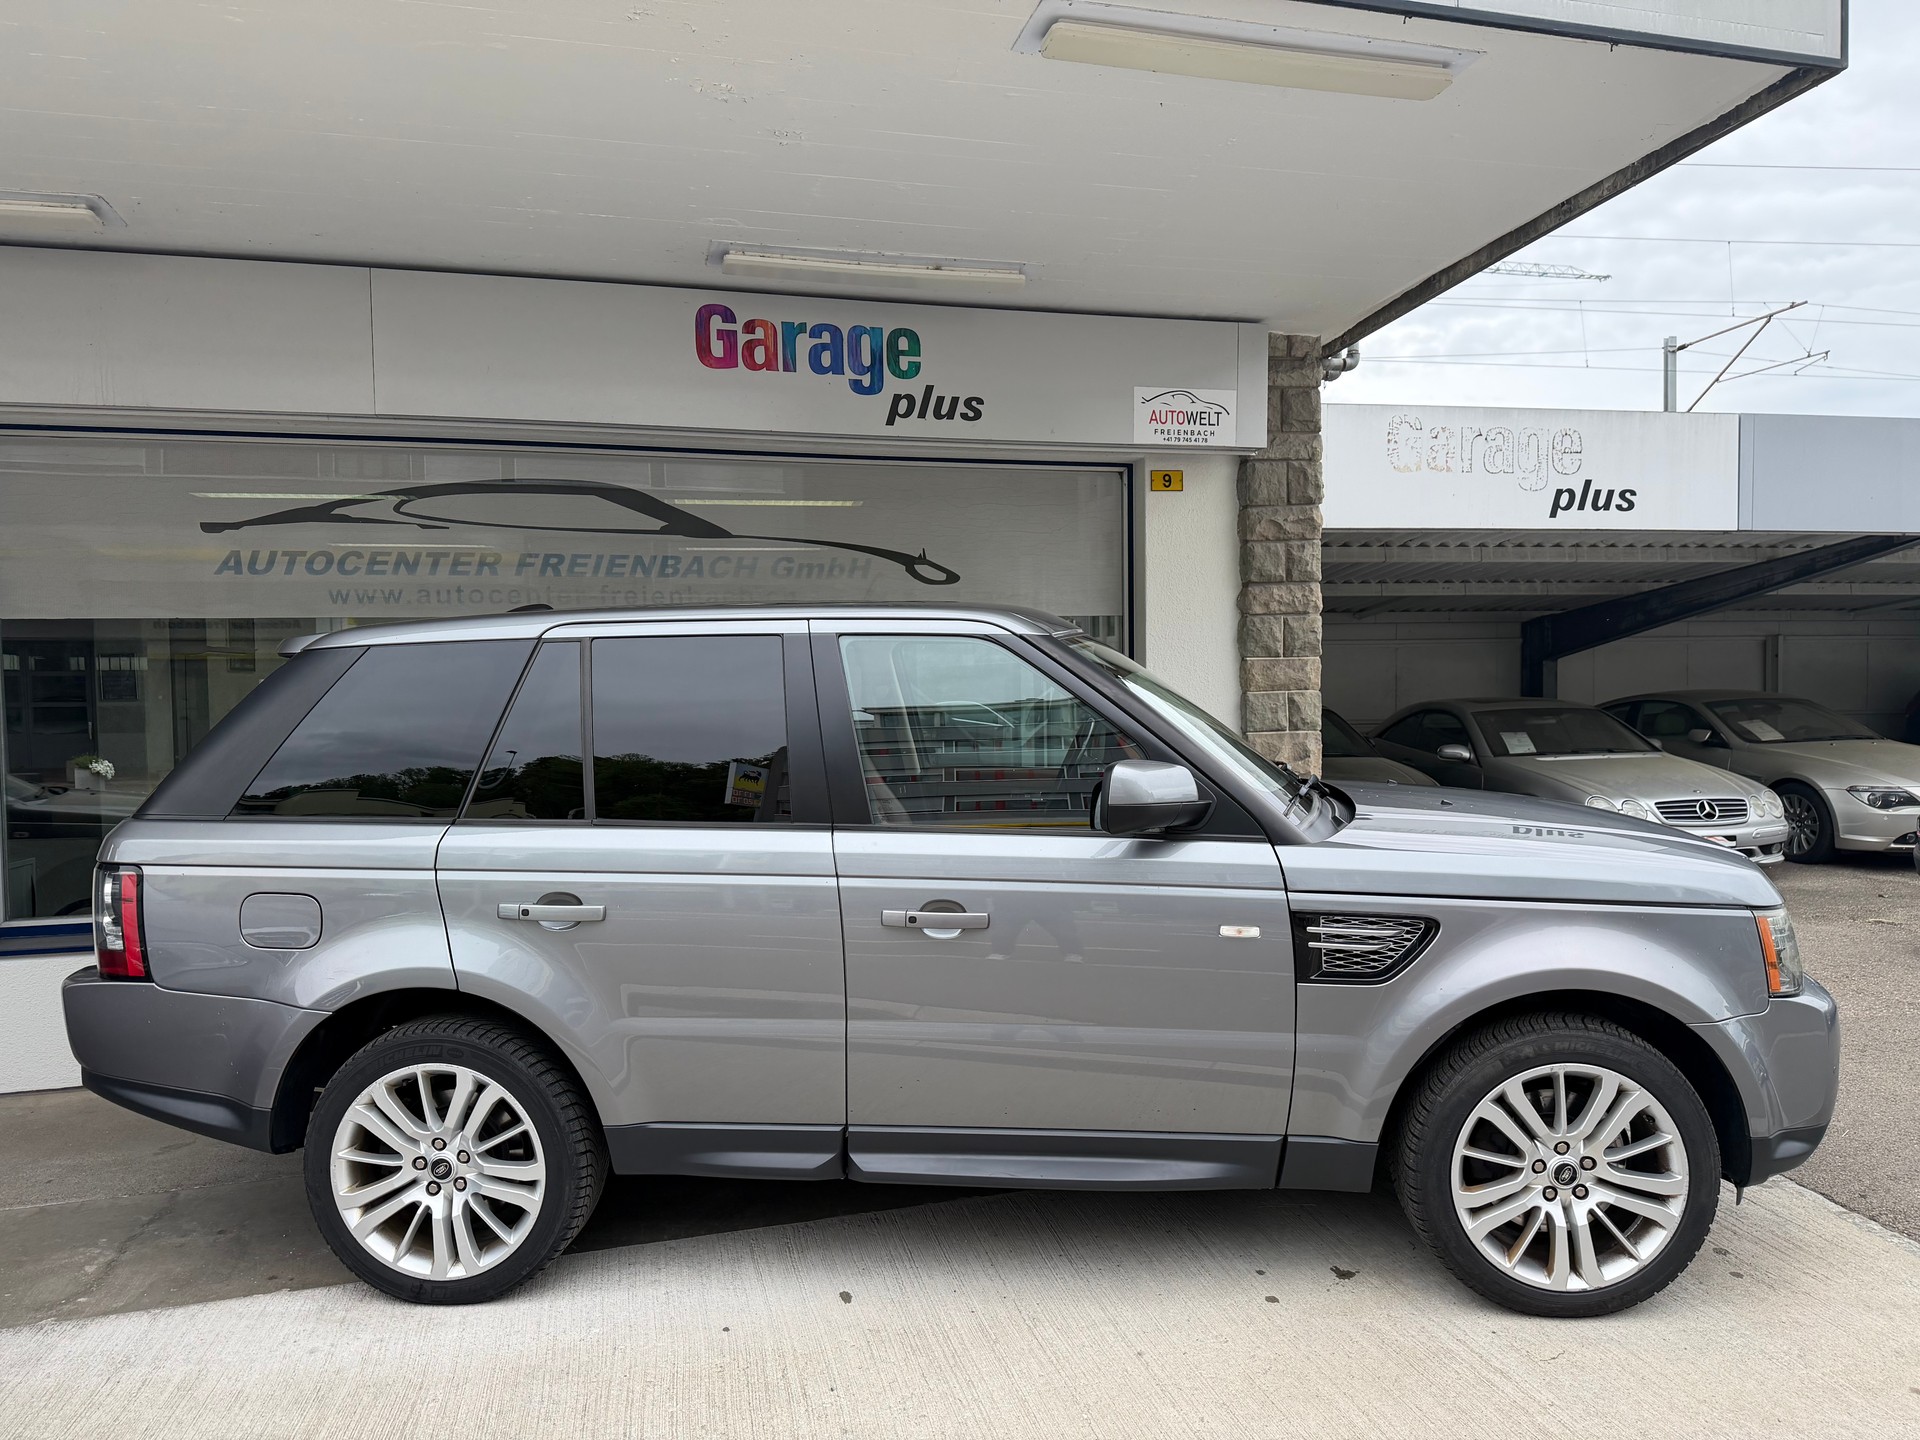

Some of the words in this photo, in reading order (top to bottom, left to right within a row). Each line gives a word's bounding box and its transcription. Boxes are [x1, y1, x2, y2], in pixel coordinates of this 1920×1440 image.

[694, 303, 922, 396] Garage
[885, 384, 985, 426] plus
[1149, 410, 1222, 426] AUTOWELT
[1153, 428, 1216, 437] FREIENBACH
[1387, 414, 1583, 492] Garage
[1162, 473, 1172, 488] 9
[1549, 479, 1637, 519] plus
[213, 549, 504, 578] AUTOCENTER
[514, 552, 758, 580] FREIENBACH
[770, 556, 873, 580] GmbH
